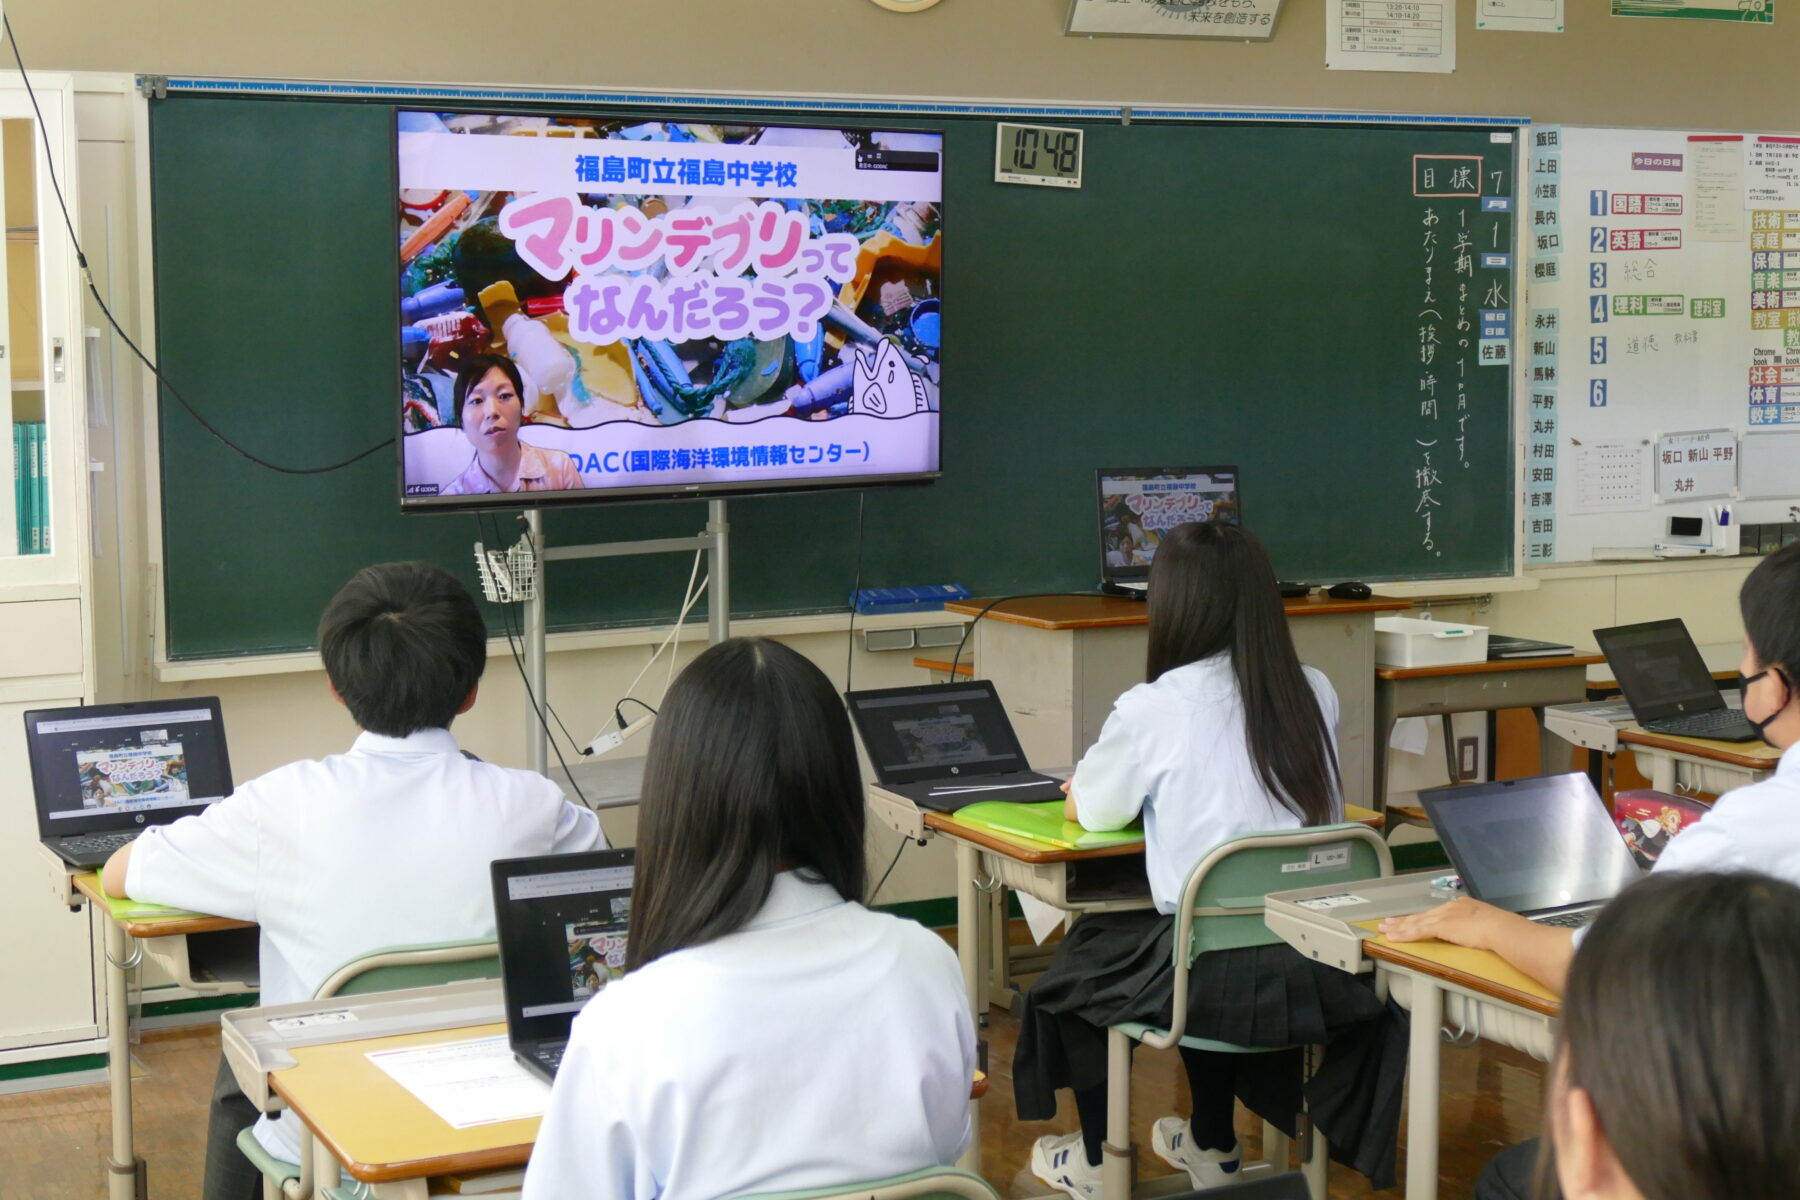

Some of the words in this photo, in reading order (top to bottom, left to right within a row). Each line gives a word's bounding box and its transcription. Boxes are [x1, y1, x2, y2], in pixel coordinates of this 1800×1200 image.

[1188, 11, 1271, 25] 未来を創造する
[1536, 131, 1557, 147] 飯田
[1535, 159, 1557, 174] 上田
[1634, 157, 1681, 167] 今日の日程
[576, 155, 798, 188] 福島町立福島中学校
[1424, 166, 1475, 190] 目標
[1535, 184, 1557, 199] 小笠原
[1595, 190, 1604, 216] 1
[1614, 195, 1642, 213] 国語
[1535, 210, 1556, 225] 長内
[508, 197, 853, 273] マリンデブリって
[1538, 235, 1559, 250] 坂口
[1592, 228, 1606, 252] 2
[1611, 231, 1641, 249] 英語
[1592, 264, 1605, 287] 3
[573, 282, 826, 334] なんだろう?
[1592, 296, 1605, 322] 4
[1615, 296, 1643, 314] 理科
[1693, 300, 1722, 317] 理科室
[1535, 314, 1556, 328] 永井
[1482, 344, 1506, 360] 佐藤
[1533, 341, 1555, 356] 新山
[1593, 338, 1606, 363] 5
[1625, 335, 1659, 354] 道徳
[1754, 348, 1776, 356] Chrome
[1754, 358, 1768, 366] book
[1751, 367, 1777, 384] 社会
[1593, 380, 1605, 405] 6
[1751, 386, 1777, 404] 体育
[1532, 394, 1554, 409] 平野
[1751, 406, 1777, 424] 数学
[1533, 419, 1555, 434] 丸井
[1533, 443, 1555, 458] 村田
[1662, 450, 1682, 464] 坂口
[1688, 447, 1708, 462] 新山
[1713, 446, 1733, 461] 平野
[1532, 467, 1553, 482] 安田
[1674, 477, 1694, 492] 丸井
[1531, 492, 1552, 506] 吉澤
[1532, 519, 1553, 533] 吉田
